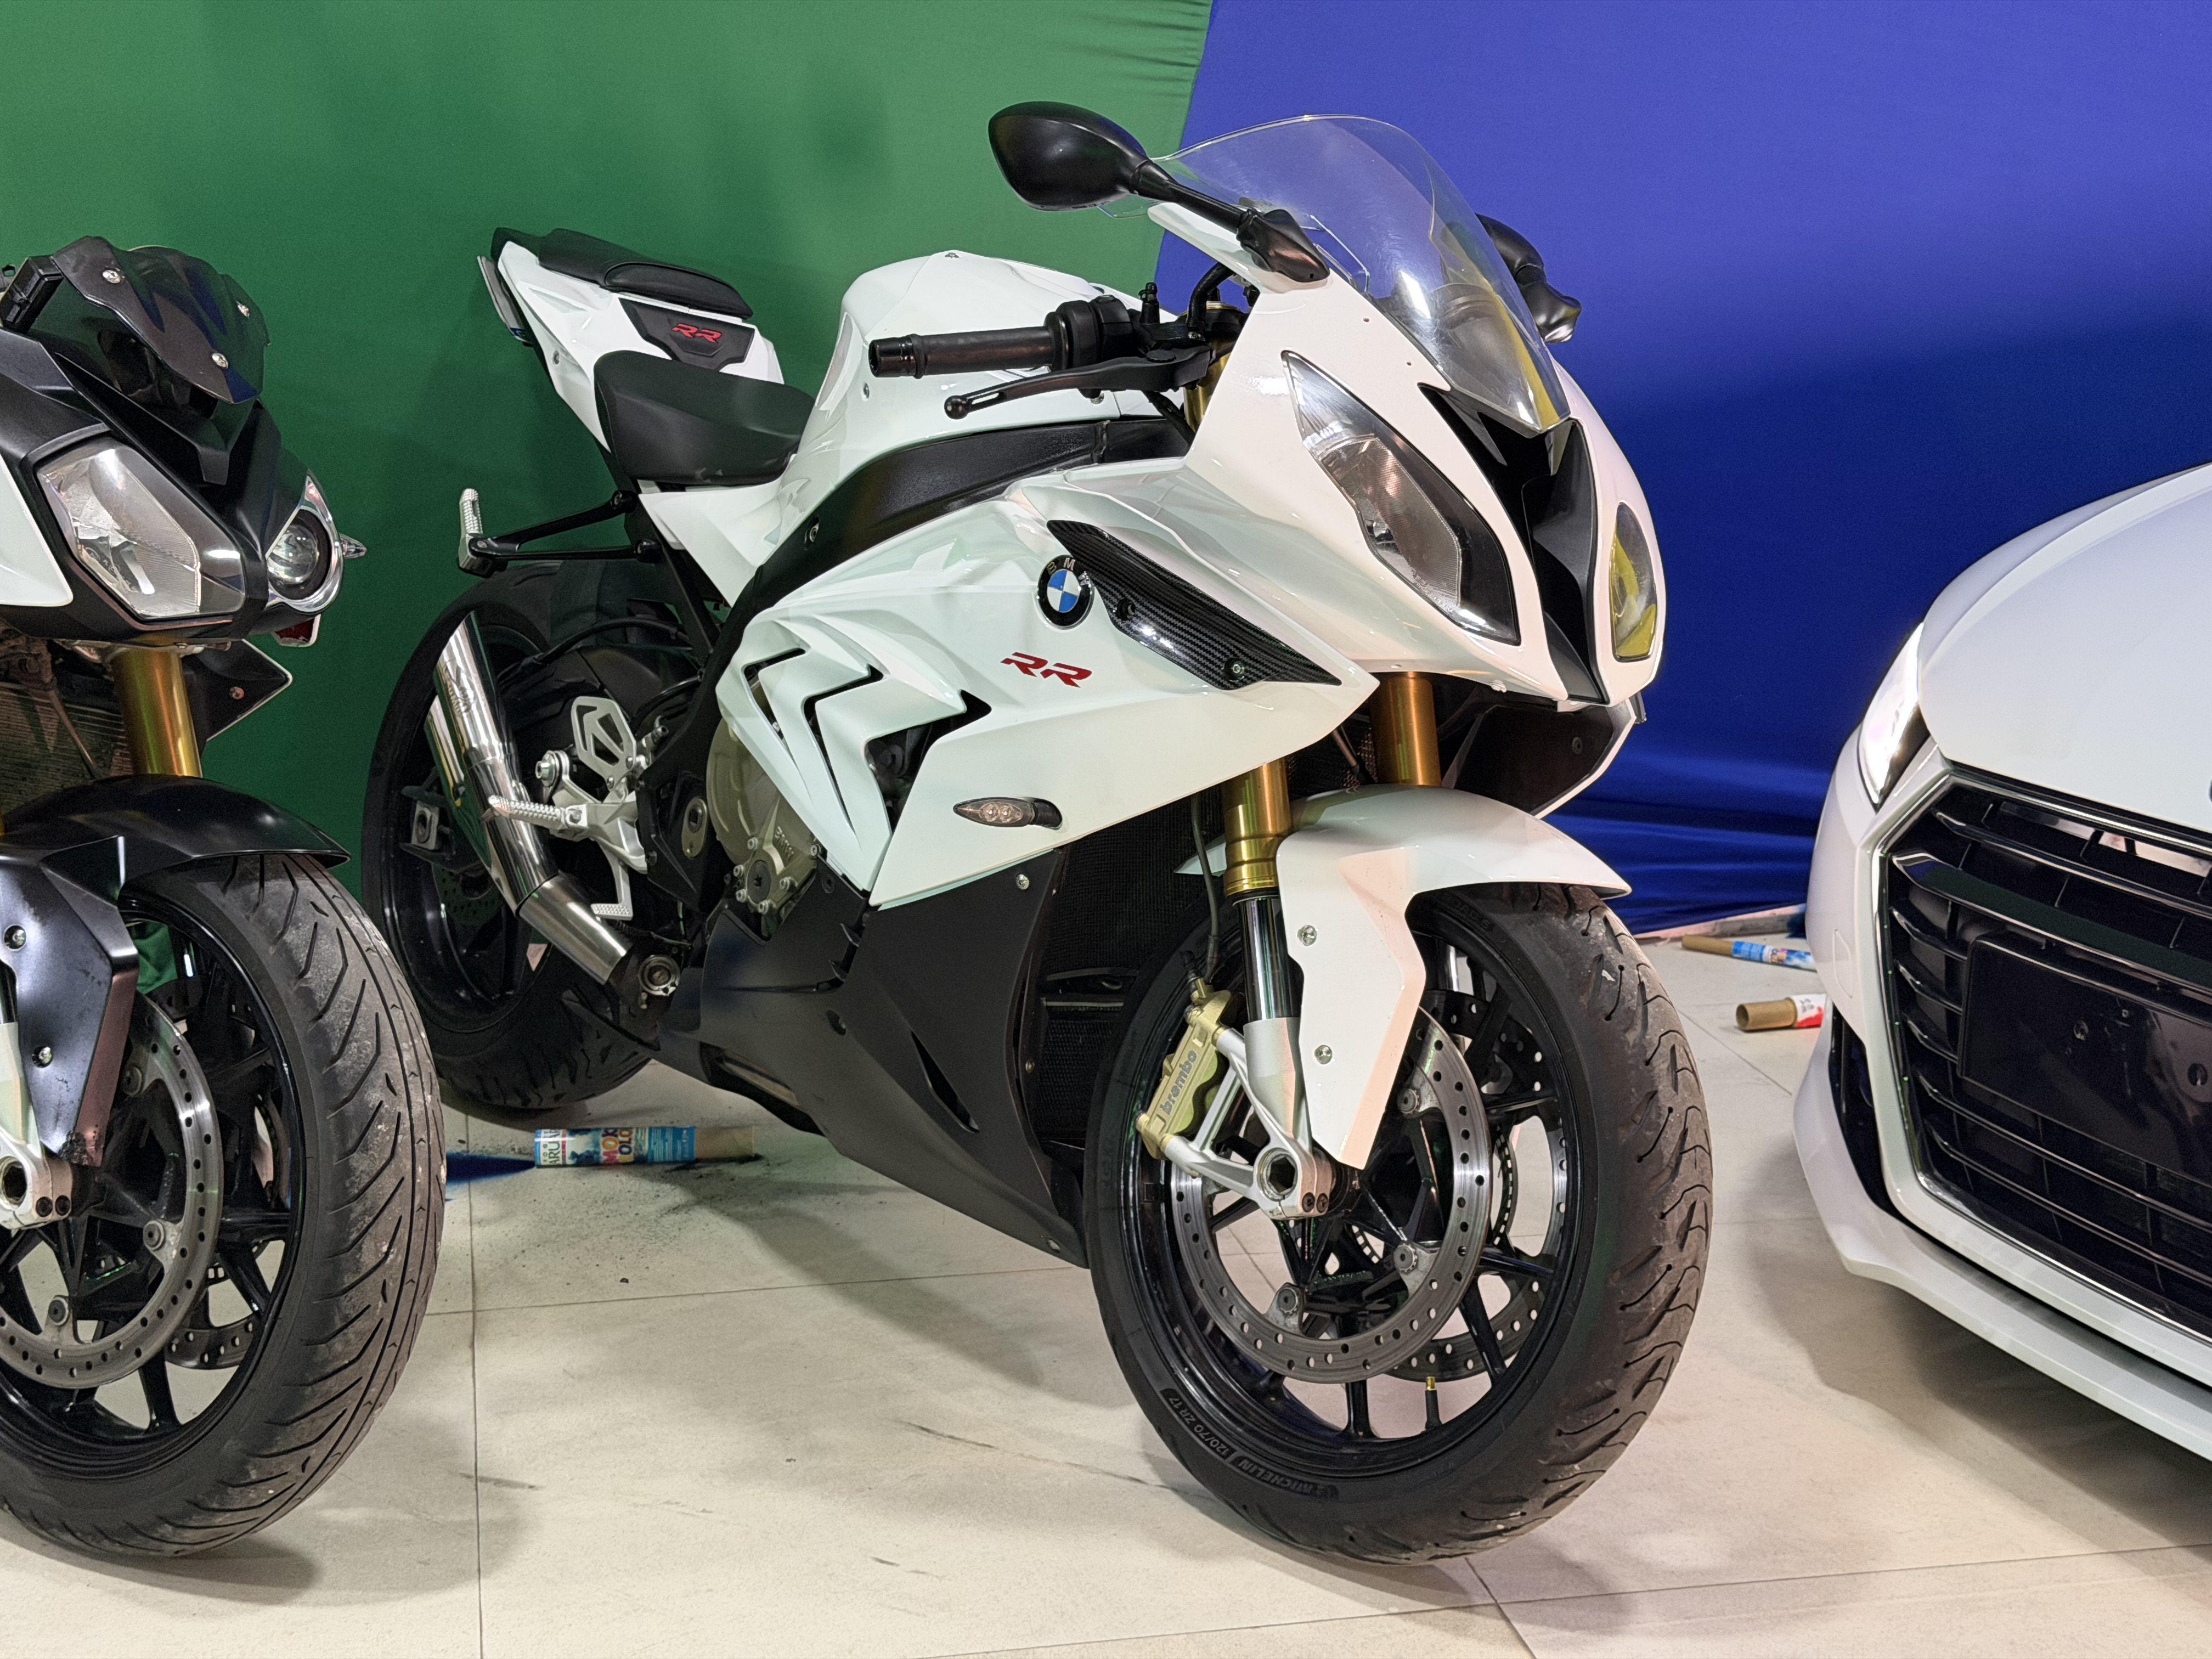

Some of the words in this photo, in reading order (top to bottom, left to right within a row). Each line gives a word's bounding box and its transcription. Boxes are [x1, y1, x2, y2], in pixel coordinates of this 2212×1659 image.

[672, 323, 723, 344] RR
[1046, 557, 1091, 588] BMW
[1000, 652, 1092, 688] RR
[1159, 1049, 1197, 1116] brembo
[1168, 1397, 1183, 1409] 17
[1179, 1408, 1196, 1425] ZR
[1194, 1424, 1229, 1455] 120/70
[1238, 1458, 1313, 1494] MICHELIN
